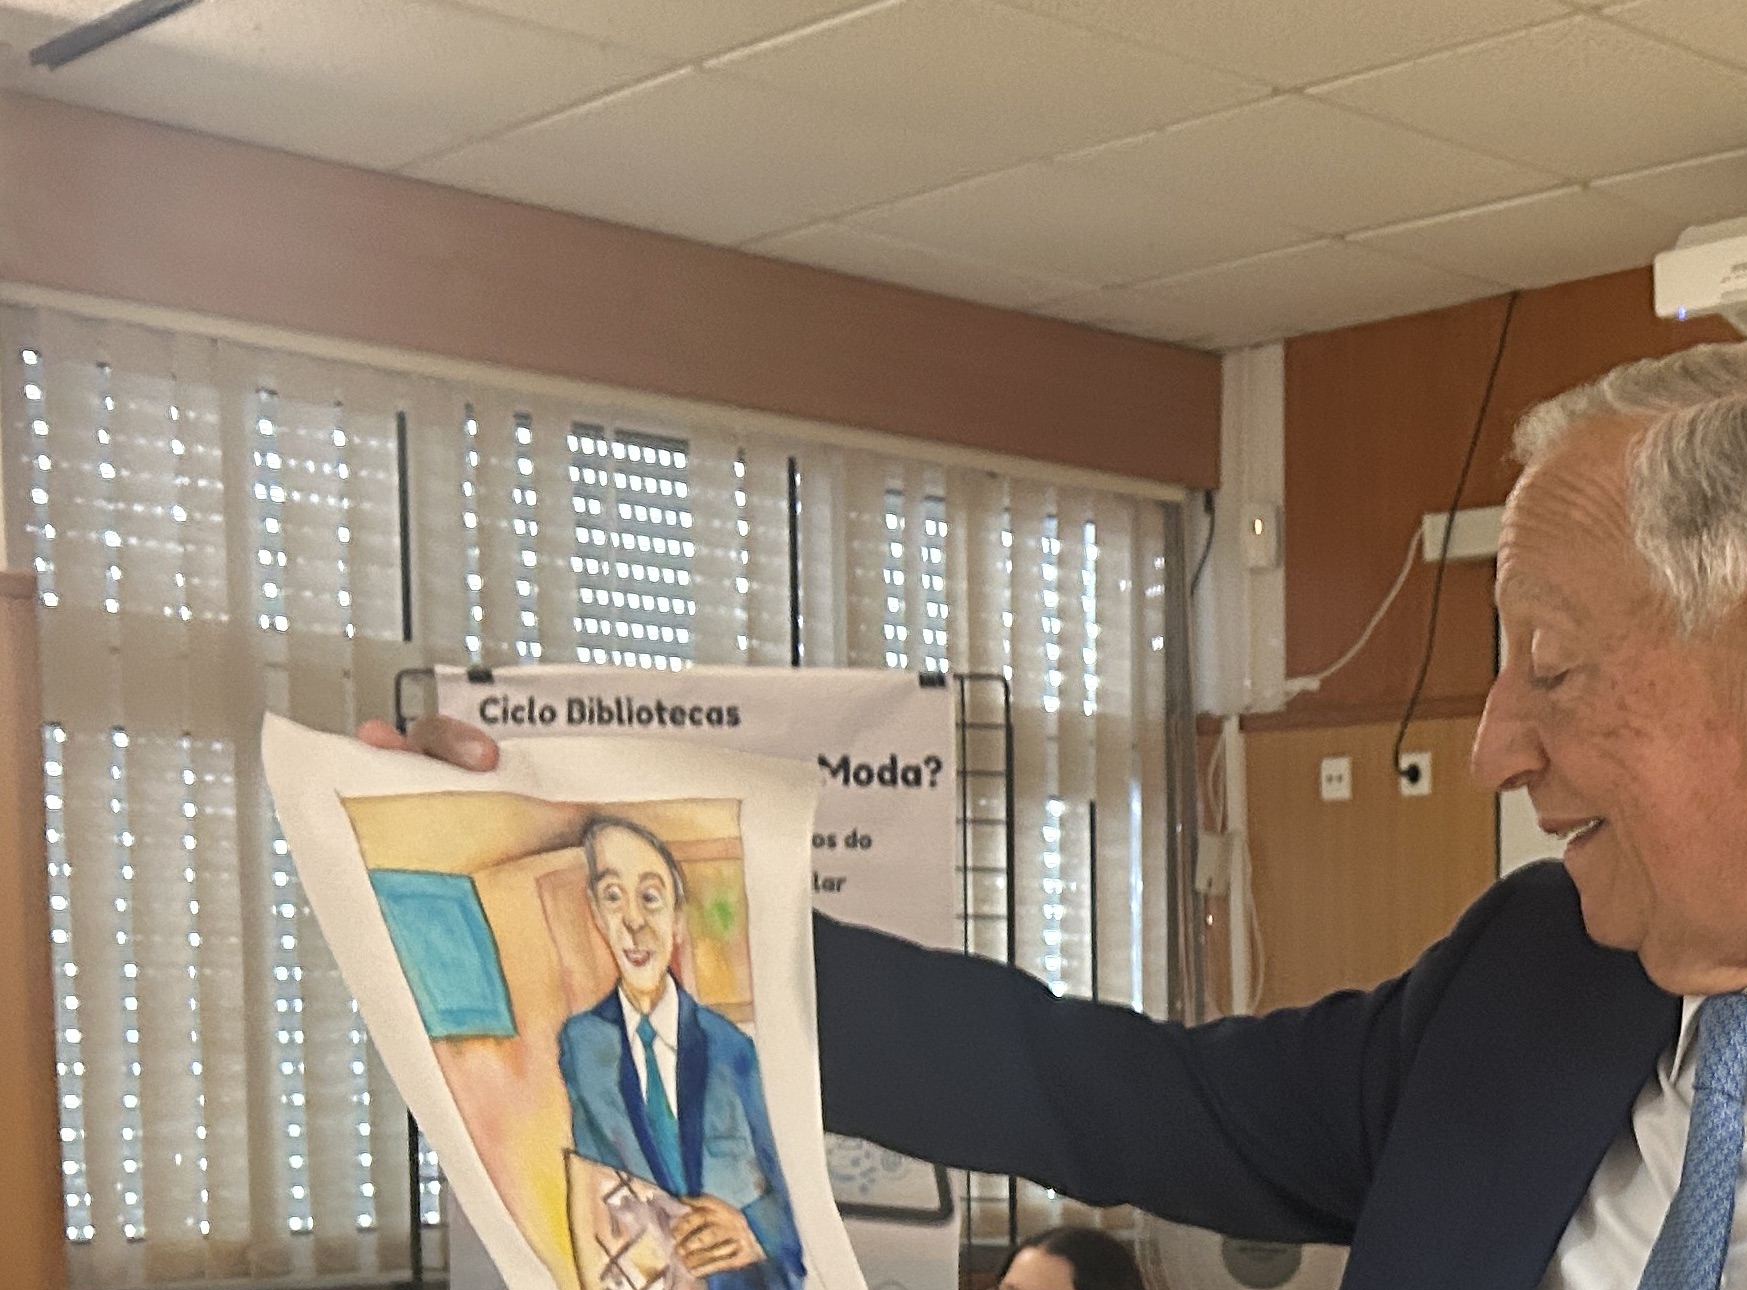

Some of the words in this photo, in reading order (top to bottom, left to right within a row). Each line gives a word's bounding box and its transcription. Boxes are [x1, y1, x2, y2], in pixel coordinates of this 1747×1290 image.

[479, 695, 557, 726] Ciclo
[567, 696, 741, 727] Bibliotecas
[818, 753, 943, 788] Moda?
[844, 827, 872, 850] do
